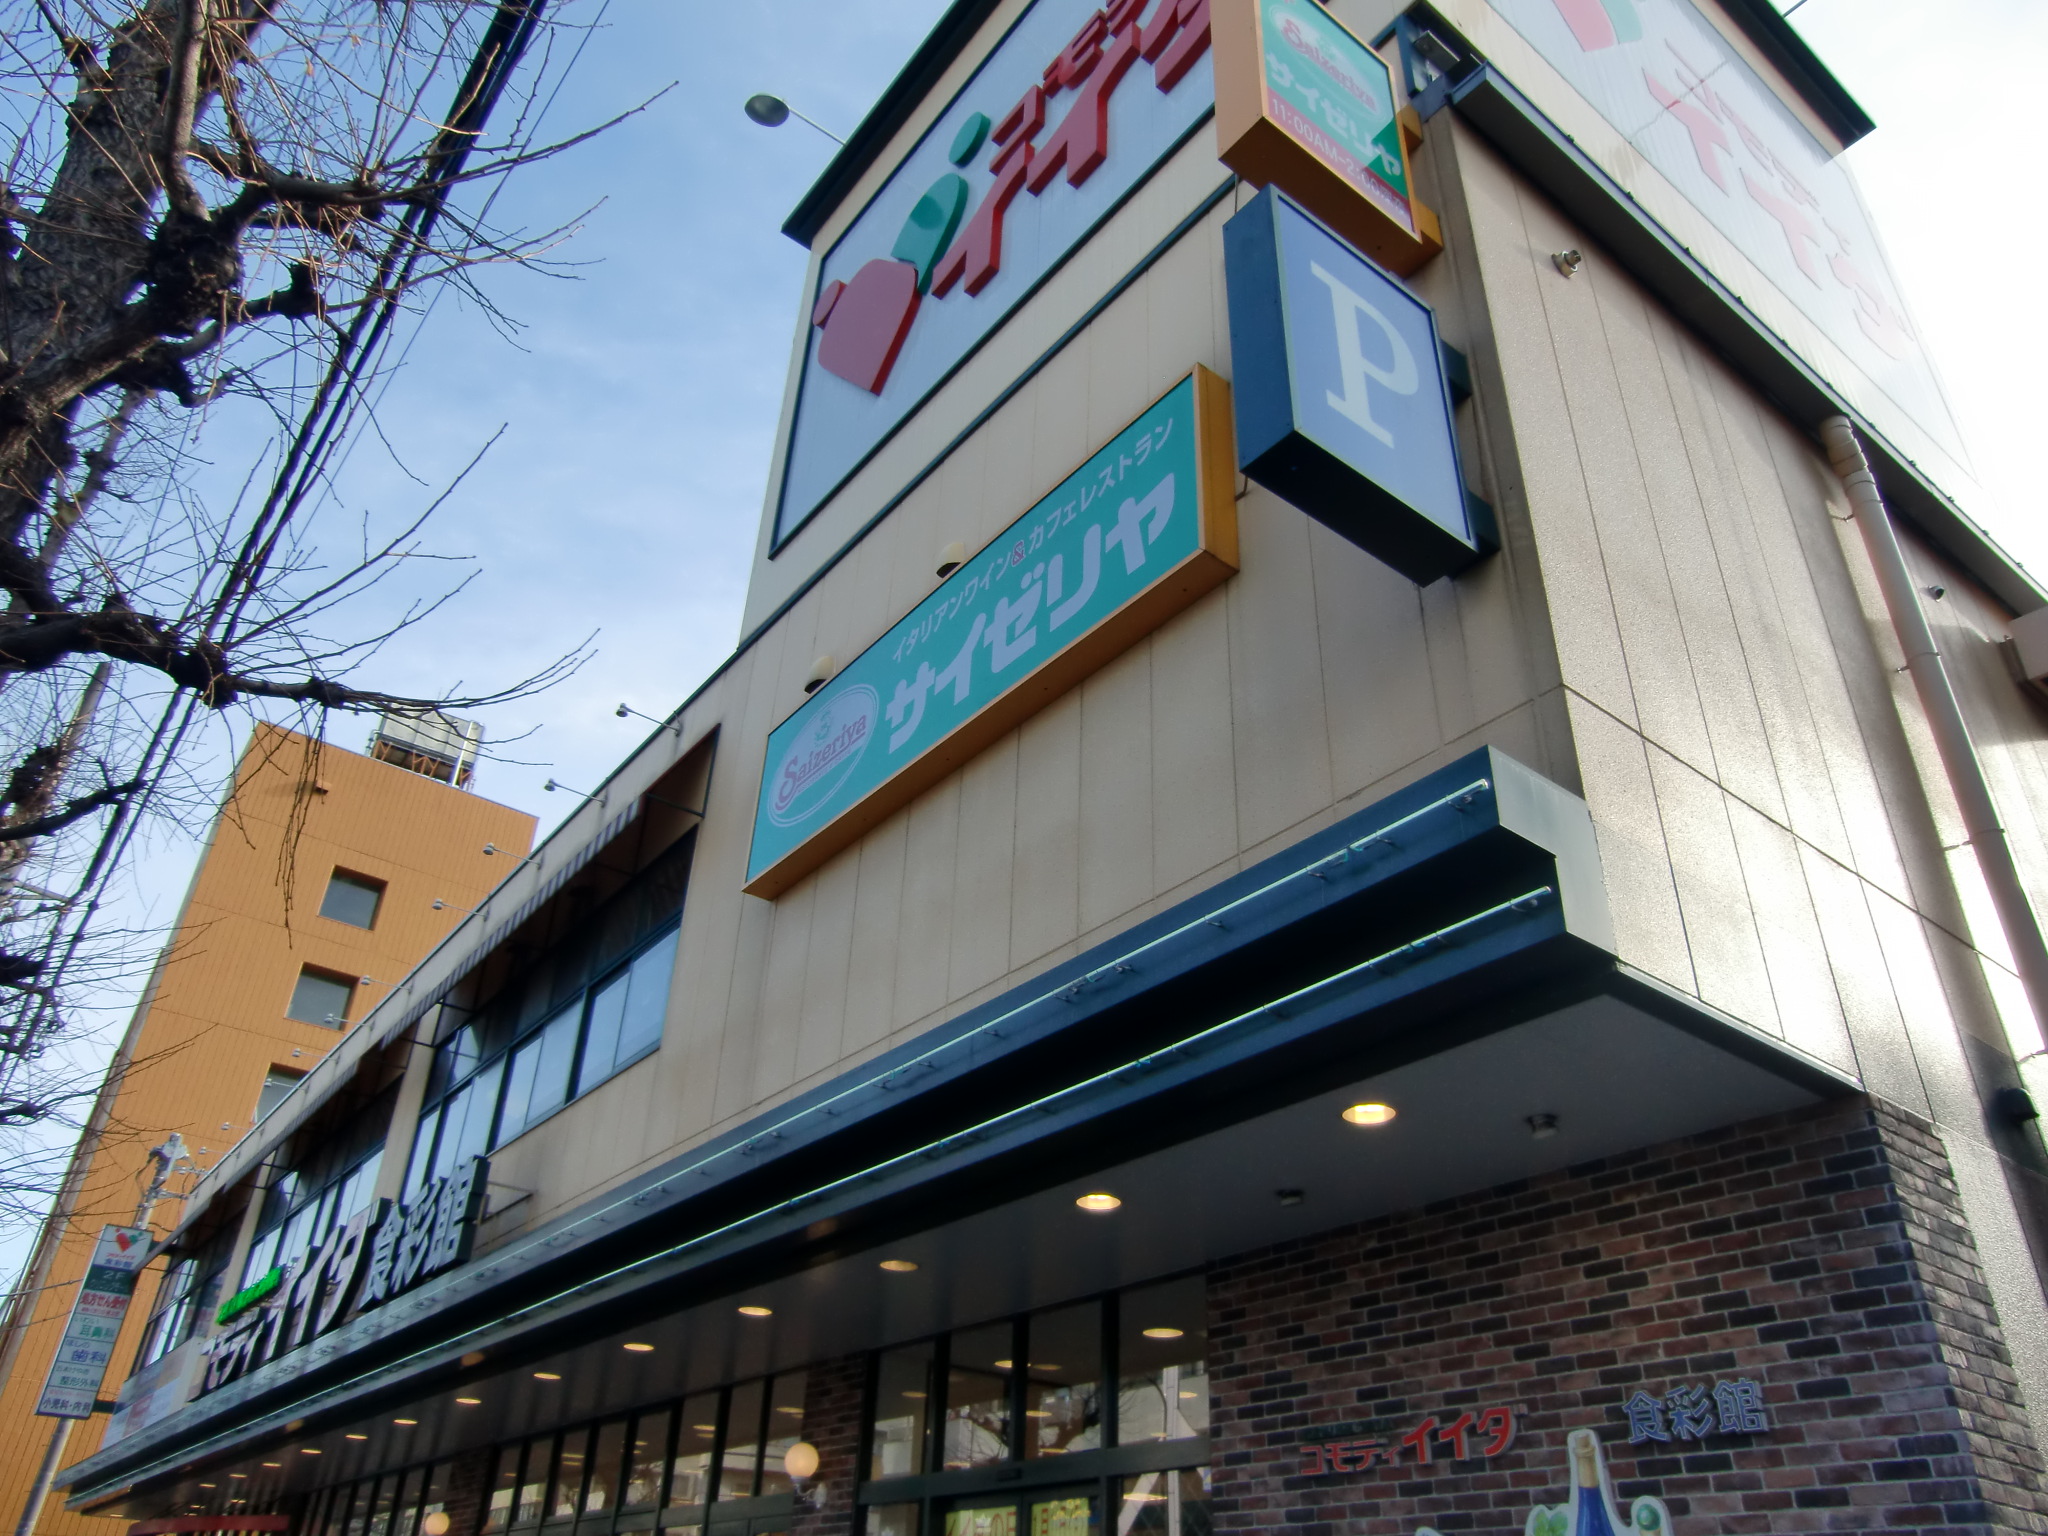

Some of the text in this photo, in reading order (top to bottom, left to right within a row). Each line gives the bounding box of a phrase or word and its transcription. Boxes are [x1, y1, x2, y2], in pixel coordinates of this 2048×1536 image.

[1281, 17, 1377, 113] Saizeriya
[1266, 52, 1402, 177] サイゼリヤ
[1310, 259, 1419, 449] P
[885, 472, 1176, 754] サイゼリヤ
[775, 714, 868, 811] Saizeriya
[103, 1269, 127, 1280] 2F
[71, 1349, 107, 1364] 歯科
[1300, 1377, 1769, 1476] コモディイイダ 食彩館
